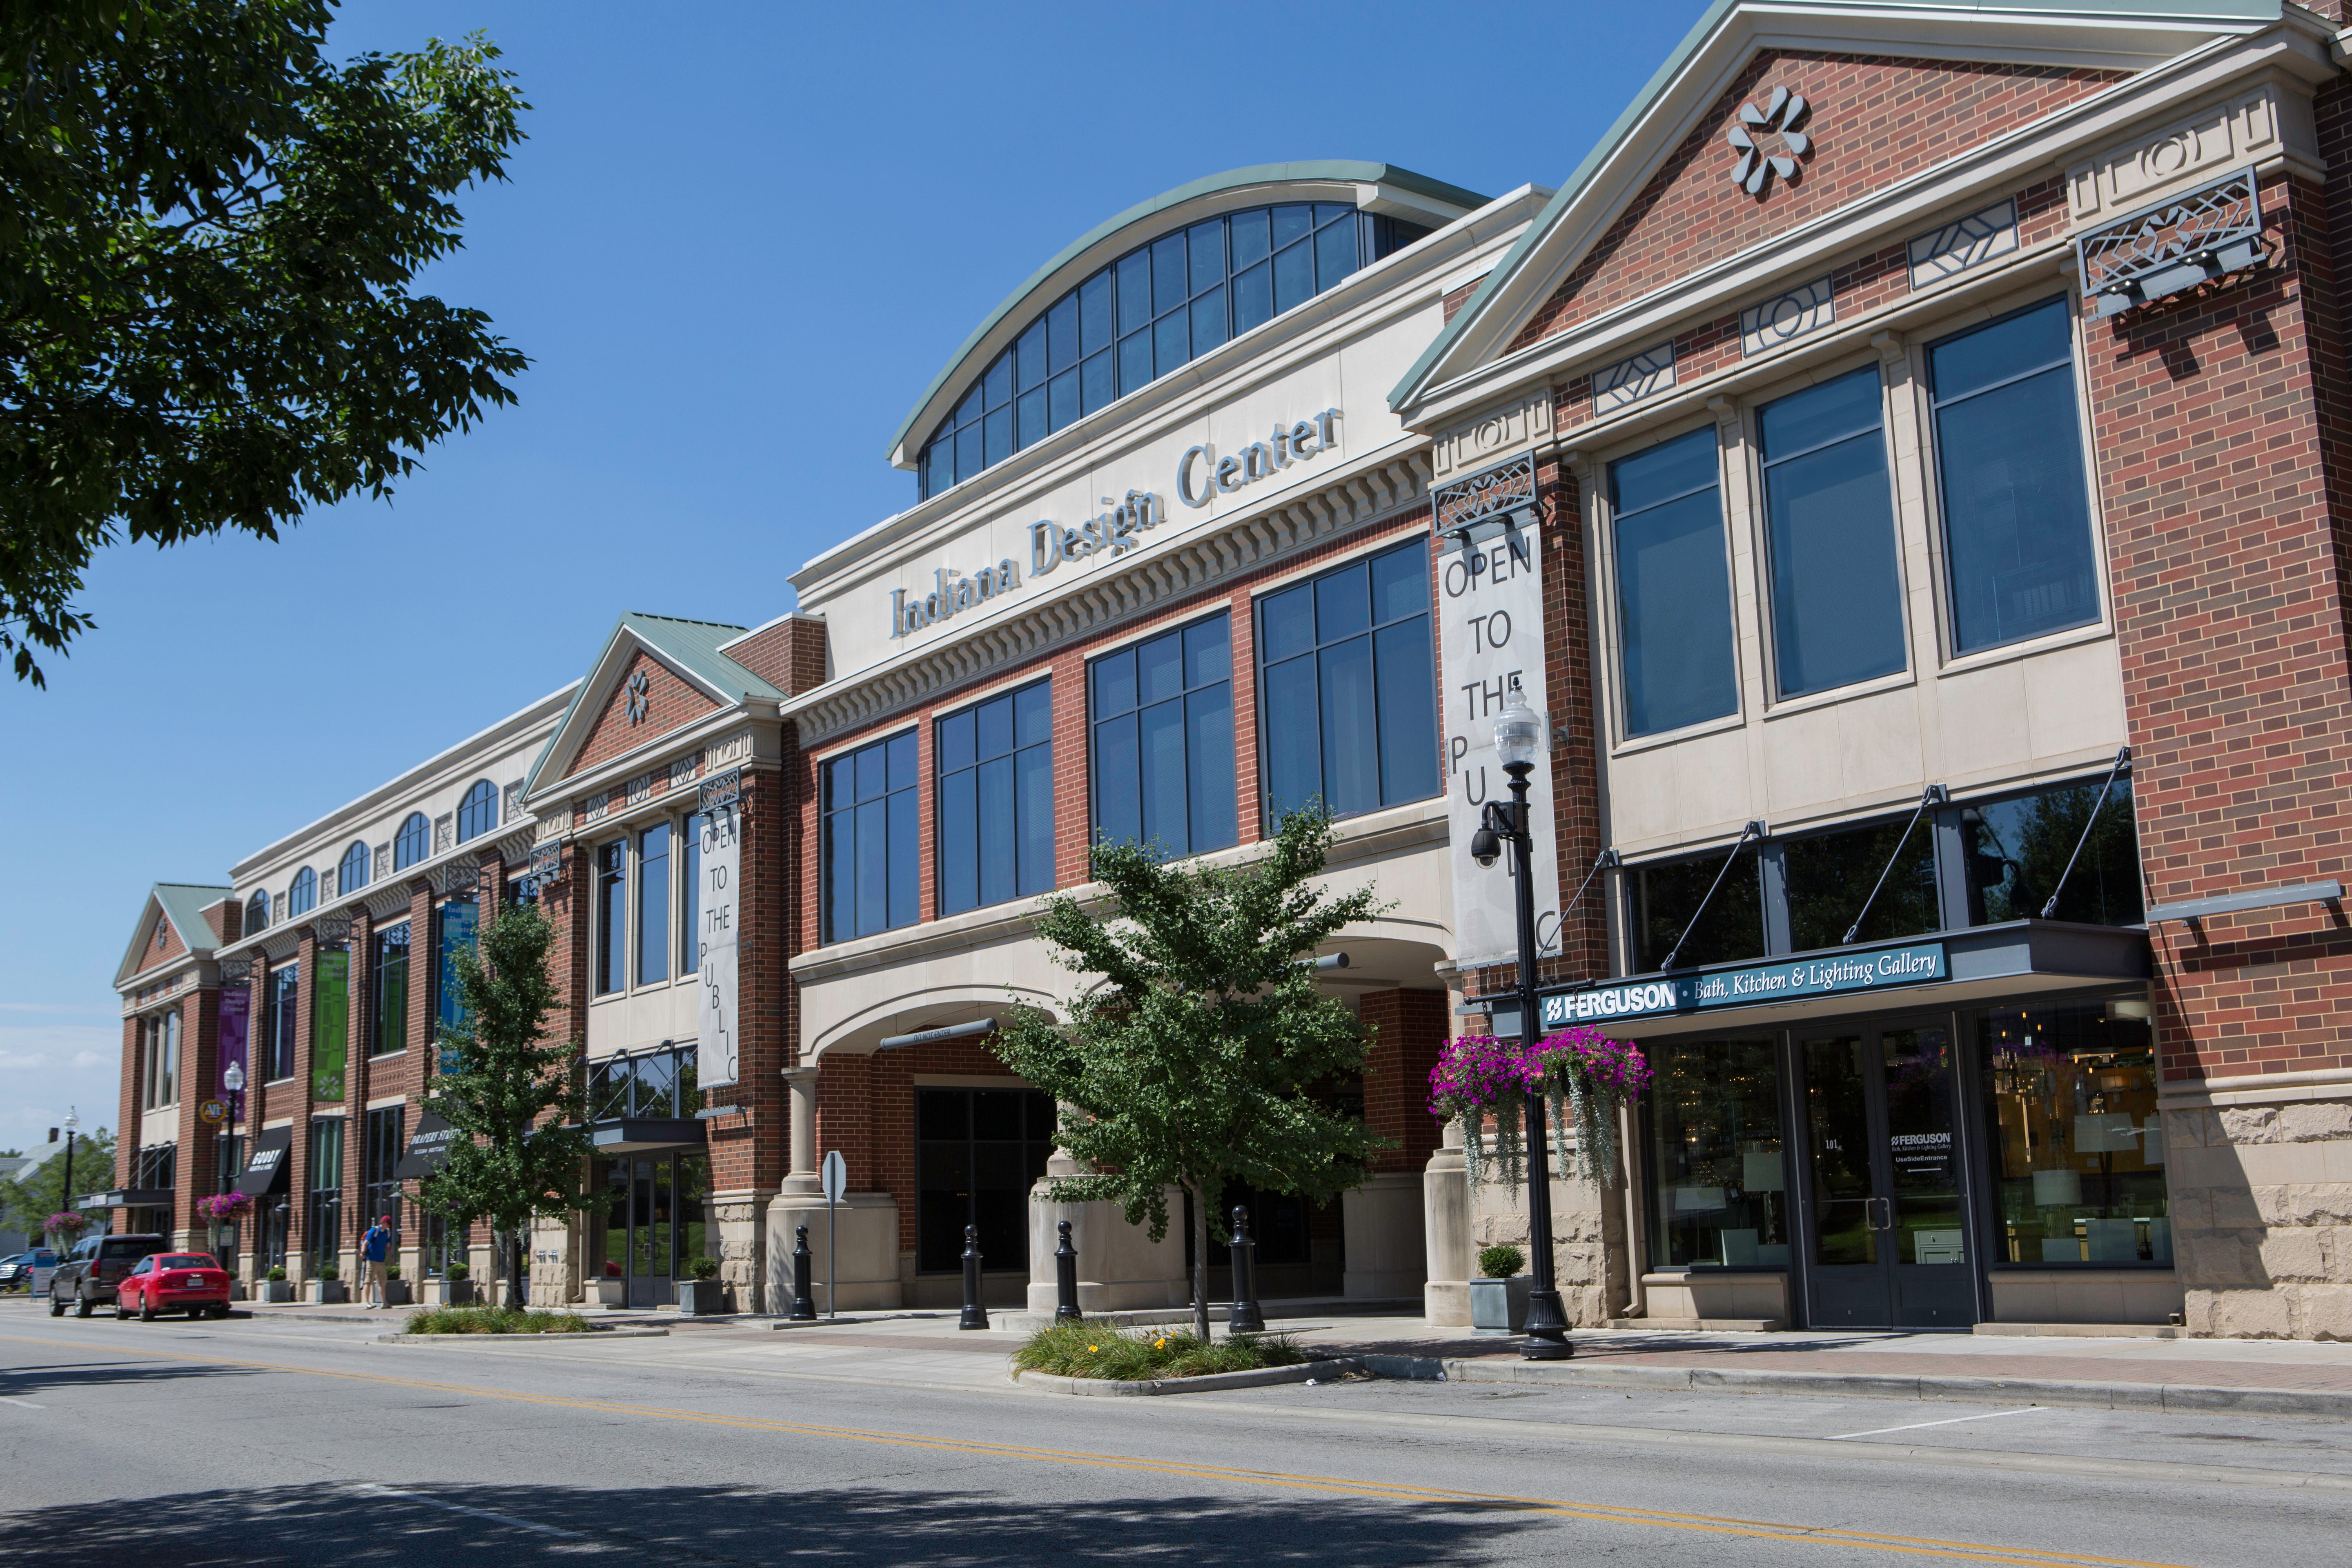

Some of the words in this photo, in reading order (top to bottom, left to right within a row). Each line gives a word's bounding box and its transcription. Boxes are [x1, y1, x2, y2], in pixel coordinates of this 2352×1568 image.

[889, 557, 1021, 640] Indiana
[1027, 488, 1167, 579] Design
[1177, 408, 1343, 508] Center
[1445, 537, 1531, 598] OPEN
[1468, 610, 1512, 654] TO
[1461, 669, 1522, 720] THE
[702, 821, 737, 854] OPEN
[710, 865, 727, 892] TO
[450, 915, 473, 924] Design
[706, 904, 730, 934] THE
[1695, 978, 1729, 999] Bath,
[1733, 971, 1787, 995] Kitchen
[1791, 967, 1805, 987] &
[1809, 960, 1874, 989] Lighting
[1878, 952, 1937, 977] Gallery
[1564, 983, 1677, 1019] FERGUSON
[410, 1131, 440, 1145] DRAPERY
[1826, 1139, 1838, 1149] 101
[1899, 1133, 1951, 1145] FERGUSON
